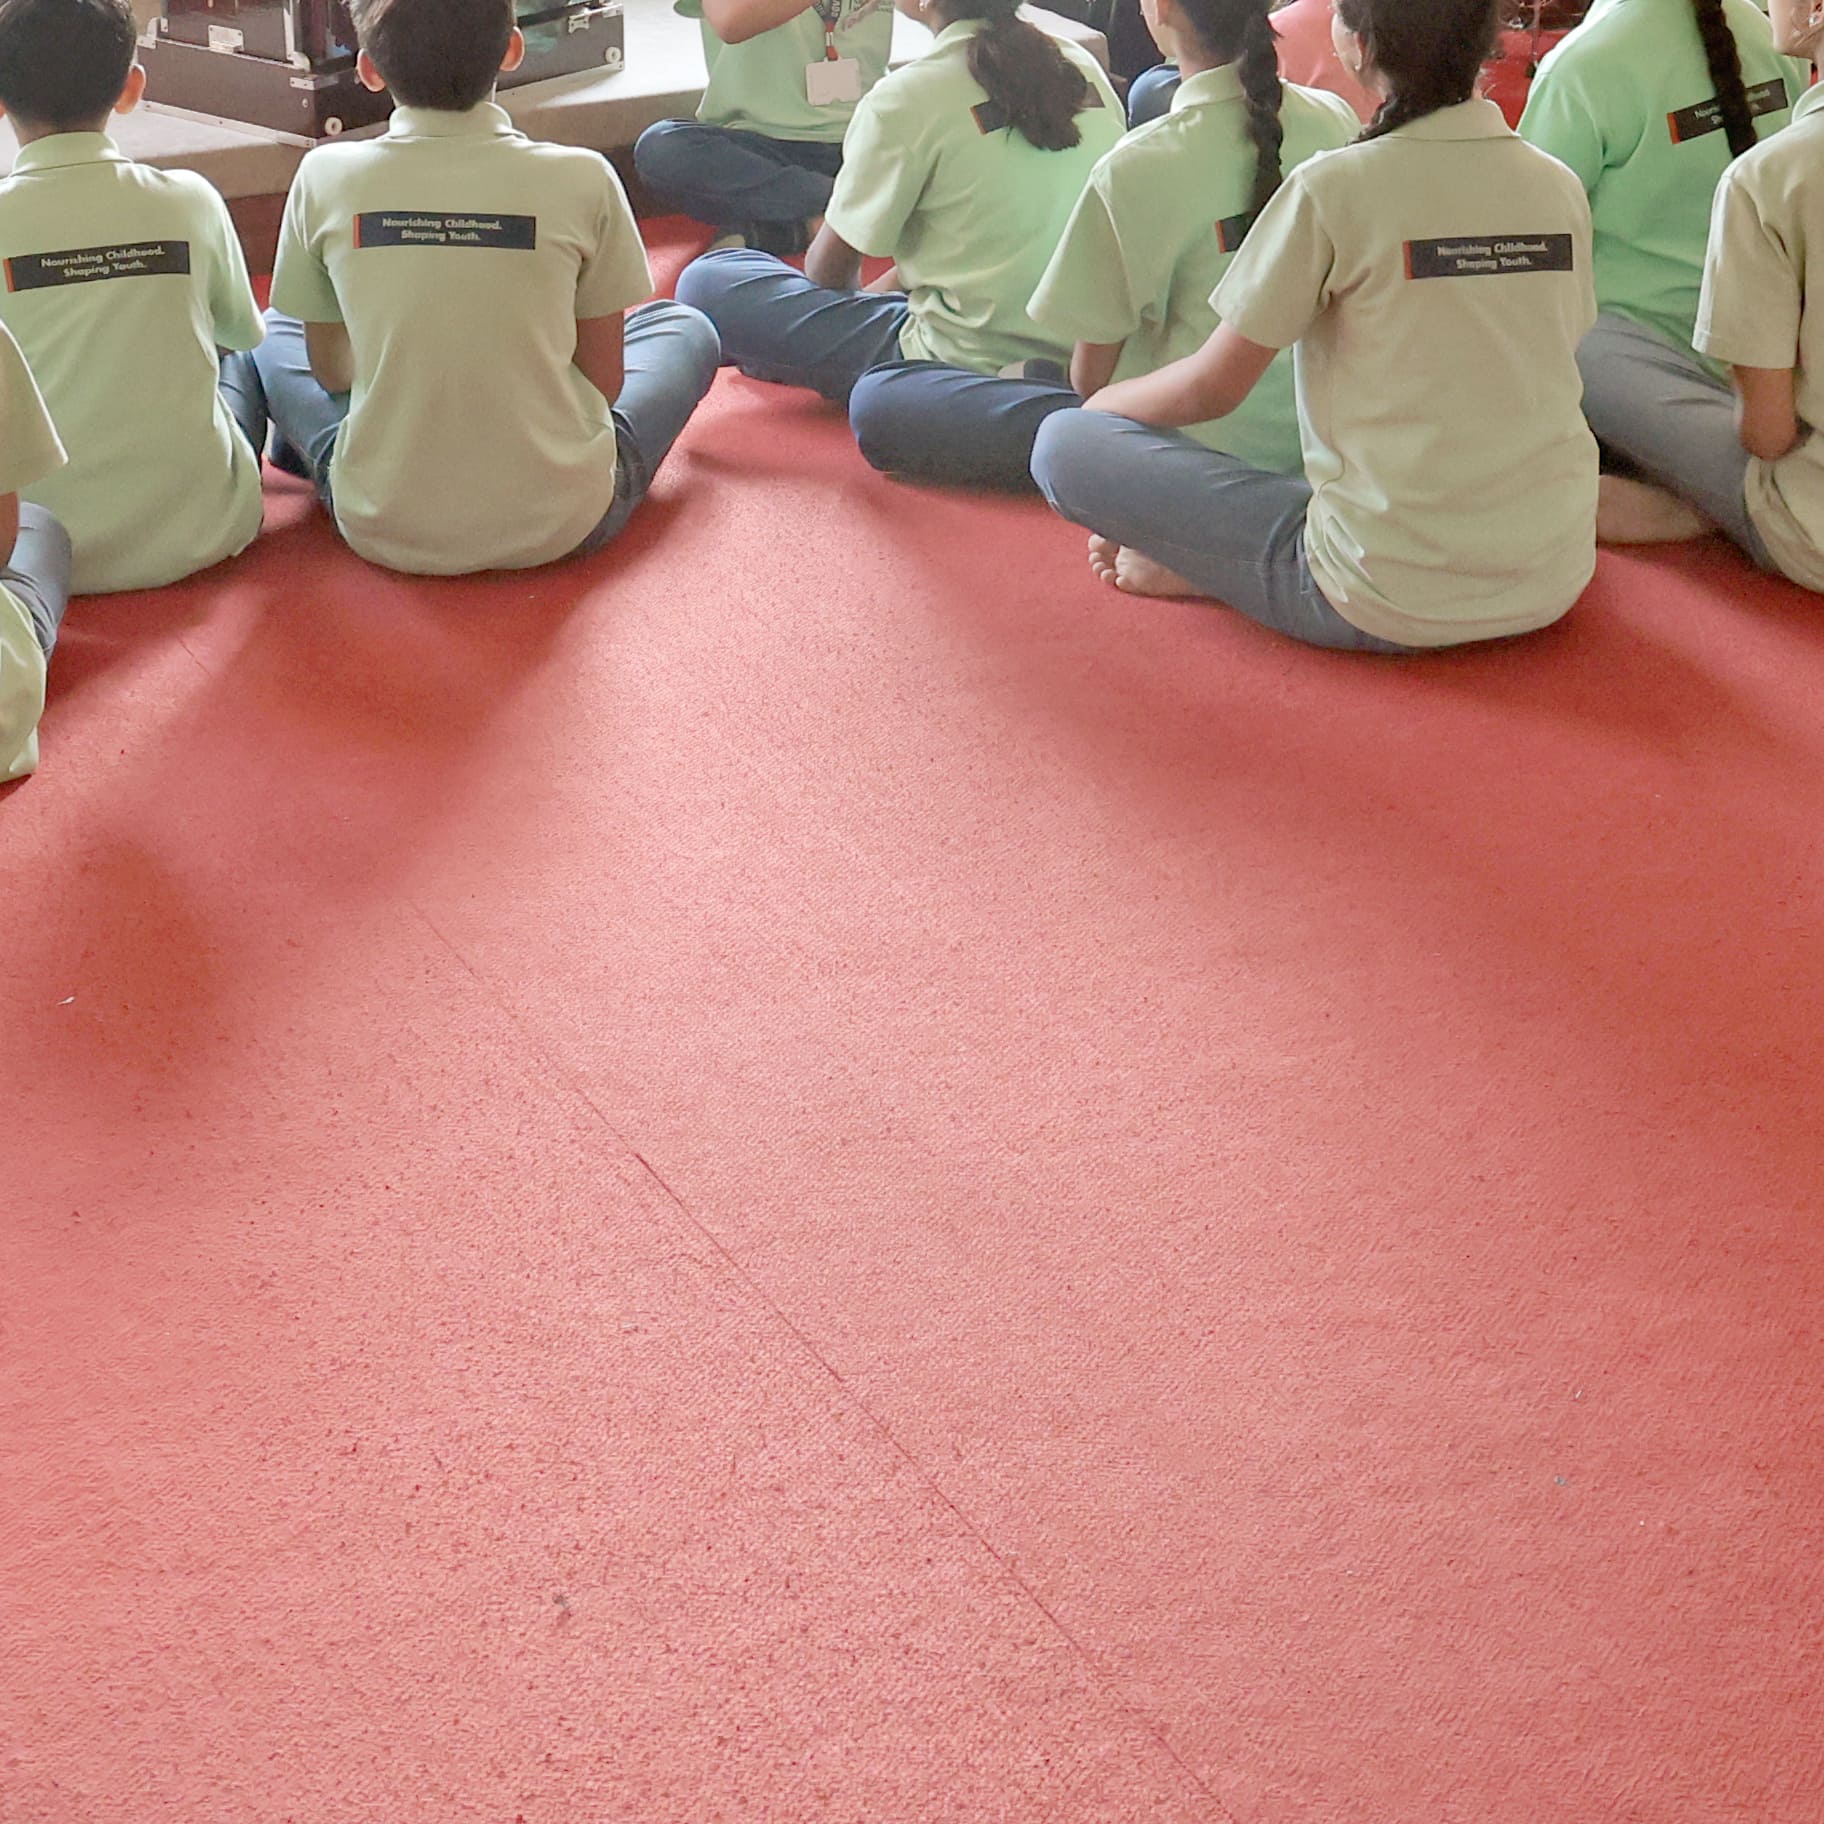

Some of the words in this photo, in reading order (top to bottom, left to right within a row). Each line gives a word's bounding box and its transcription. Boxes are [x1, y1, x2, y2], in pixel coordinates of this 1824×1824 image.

[382, 217, 442, 229] Nourishing
[401, 229, 446, 241] Shaping
[40, 251, 104, 267] Nourishing
[63, 263, 110, 277] Shaping
